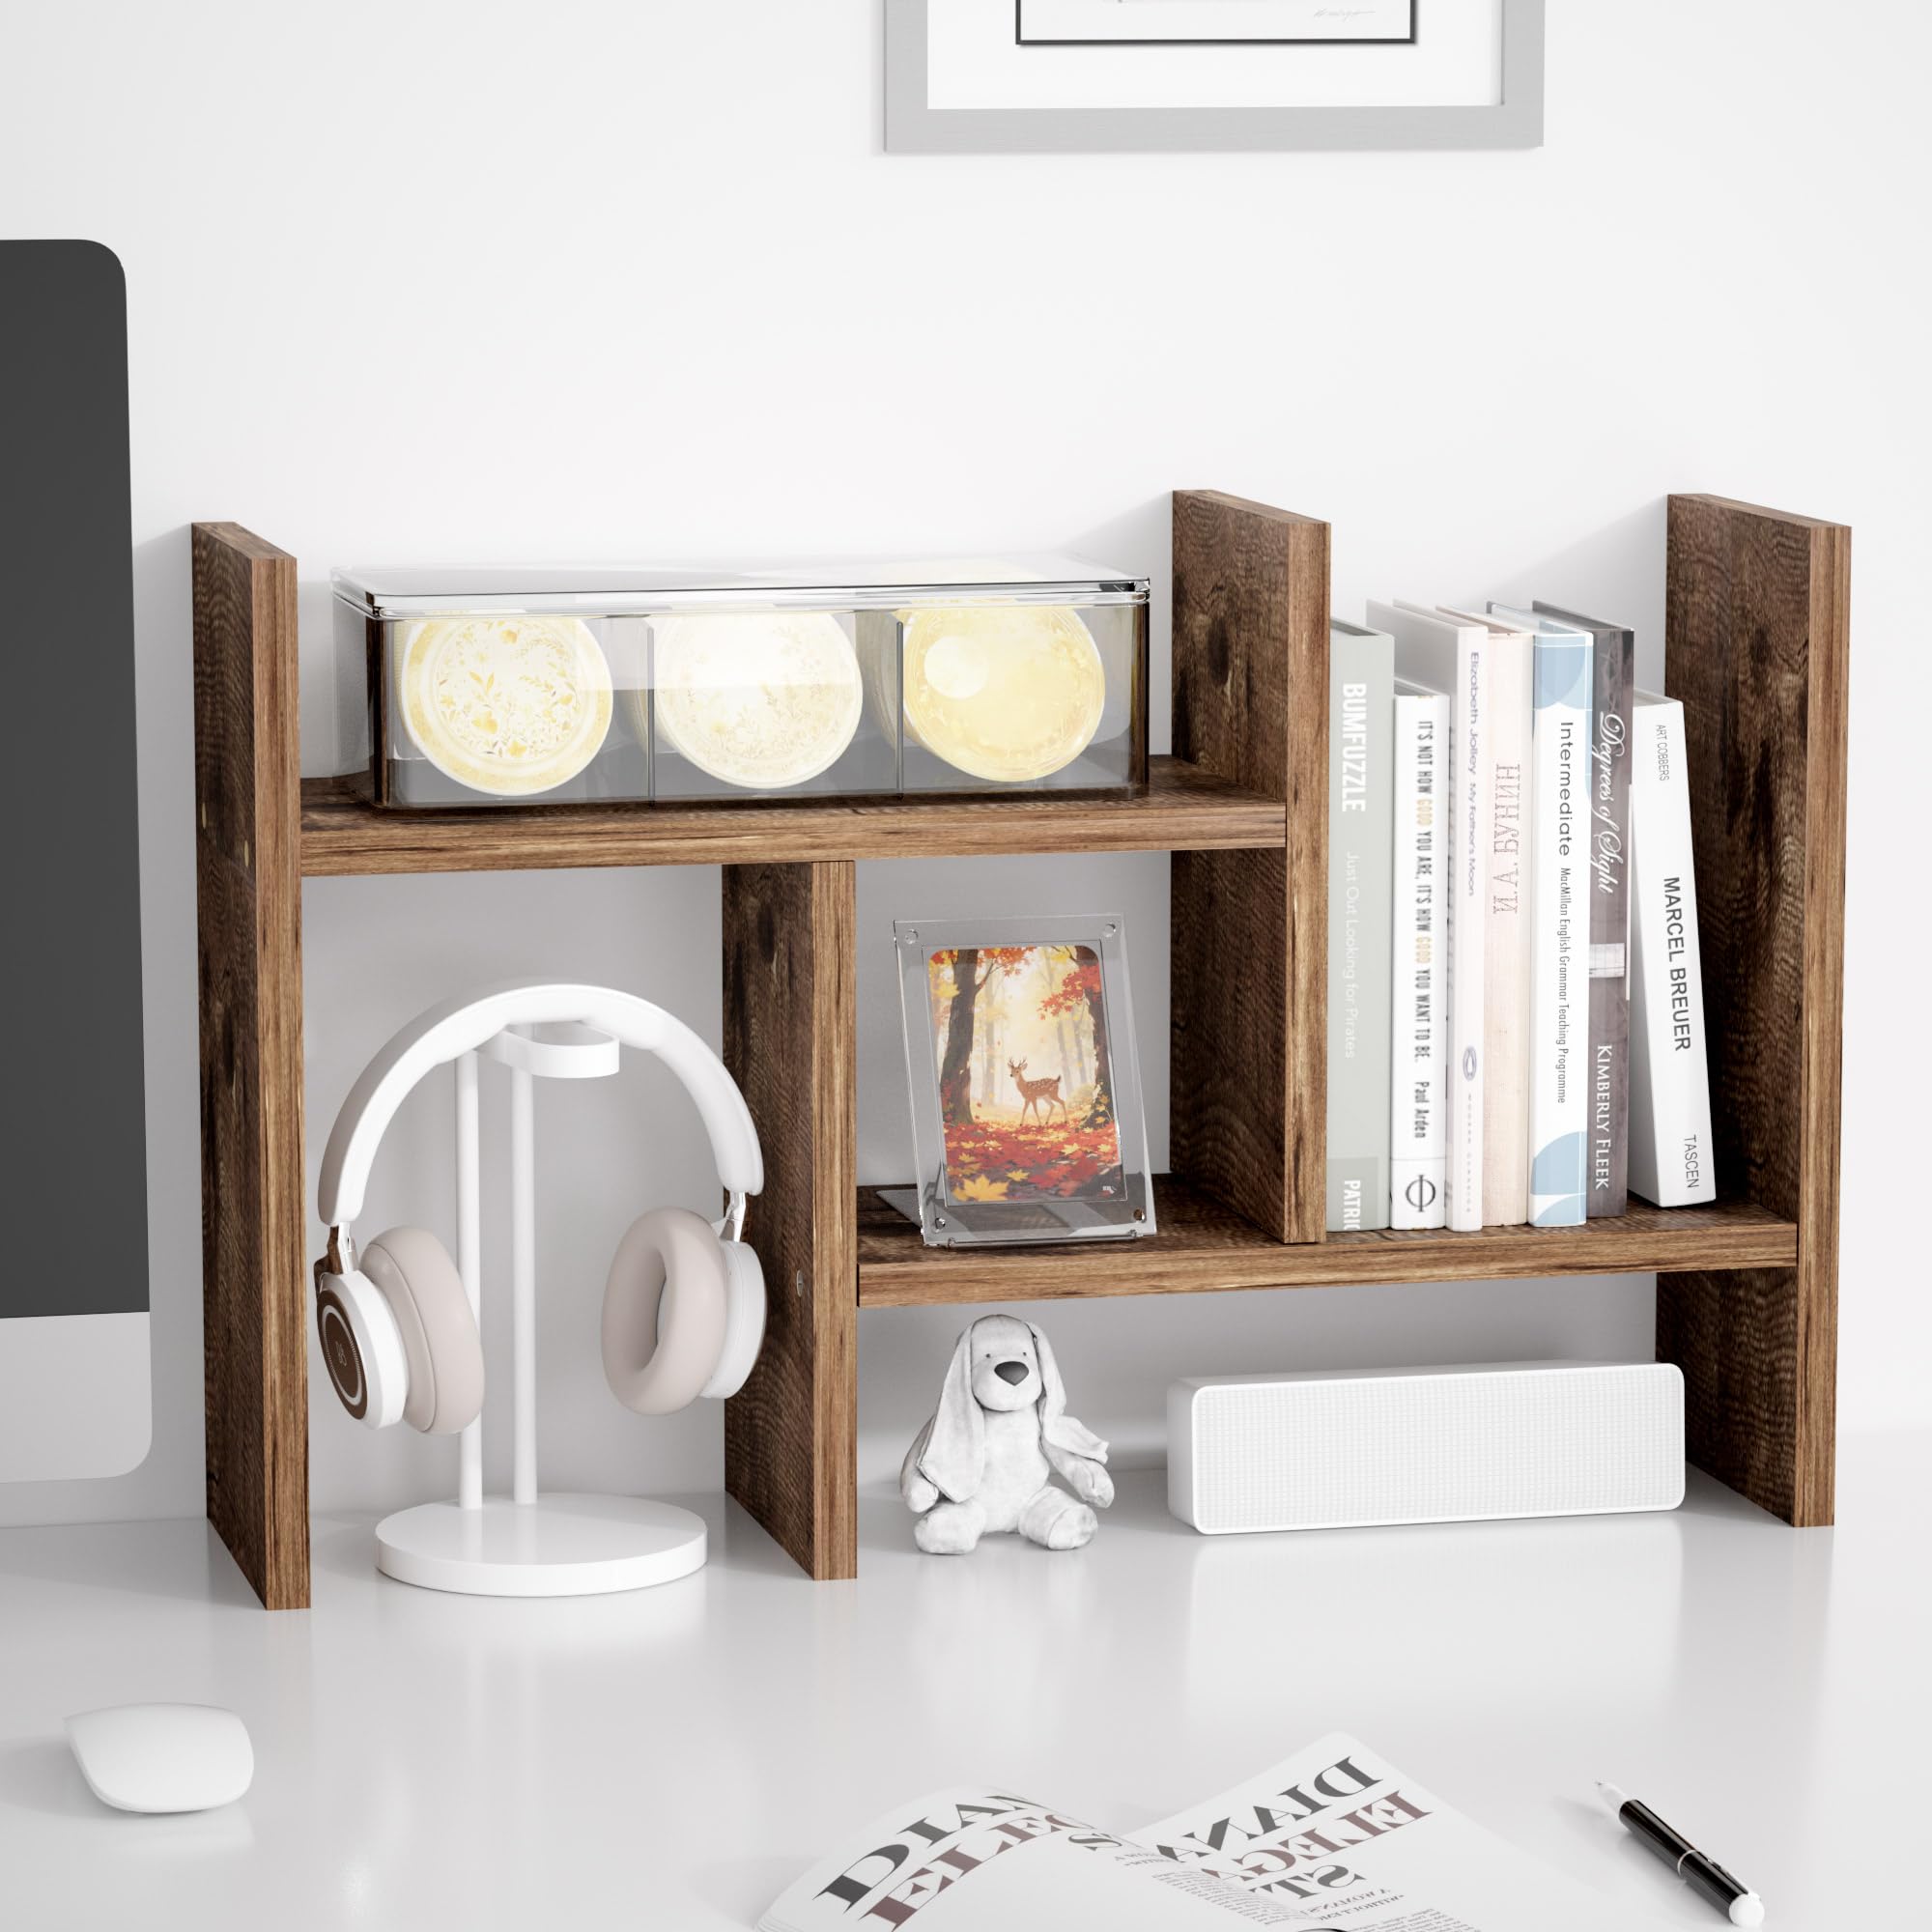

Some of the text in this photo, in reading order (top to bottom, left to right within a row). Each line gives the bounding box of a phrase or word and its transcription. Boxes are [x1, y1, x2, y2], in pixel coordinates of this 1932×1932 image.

[1417, 721, 1434, 740] IT'S
[1468, 652, 1479, 775] Elizabeth Jolley
[1342, 683, 1367, 812] BUMFUZZLE
[1417, 745, 1433, 765] NOT
[1656, 724, 1669, 781] ART COBBERS
[1417, 771, 1433, 794] HOW
[1468, 782, 1476, 803] My
[1559, 722, 1574, 857] Intermediate
[1590, 711, 1625, 894] Degrees of Sight
[1416, 799, 1433, 826] GOOD
[1494, 763, 1520, 855] БУНИН
[1416, 831, 1432, 851] YOU
[1416, 885, 1432, 904] IT'S
[1416, 908, 1432, 932] HOW
[1343, 851, 1360, 1060] Just Out Looking for Pirates
[1416, 936, 1432, 964] GOOD
[1663, 876, 1691, 1052] MARCEL BREUER
[1415, 969, 1431, 989] YOU
[1556, 867, 1572, 1103] MacMillan English Grammar Teaching Programme
[1415, 994, 1431, 1022] WANT
[1415, 1028, 1431, 1040] TO
[1414, 1081, 1431, 1138] Paul Arden
[1595, 1045, 1612, 1189] KIMBERLY FLEEK
[1684, 1133, 1700, 1189] TASCEN
